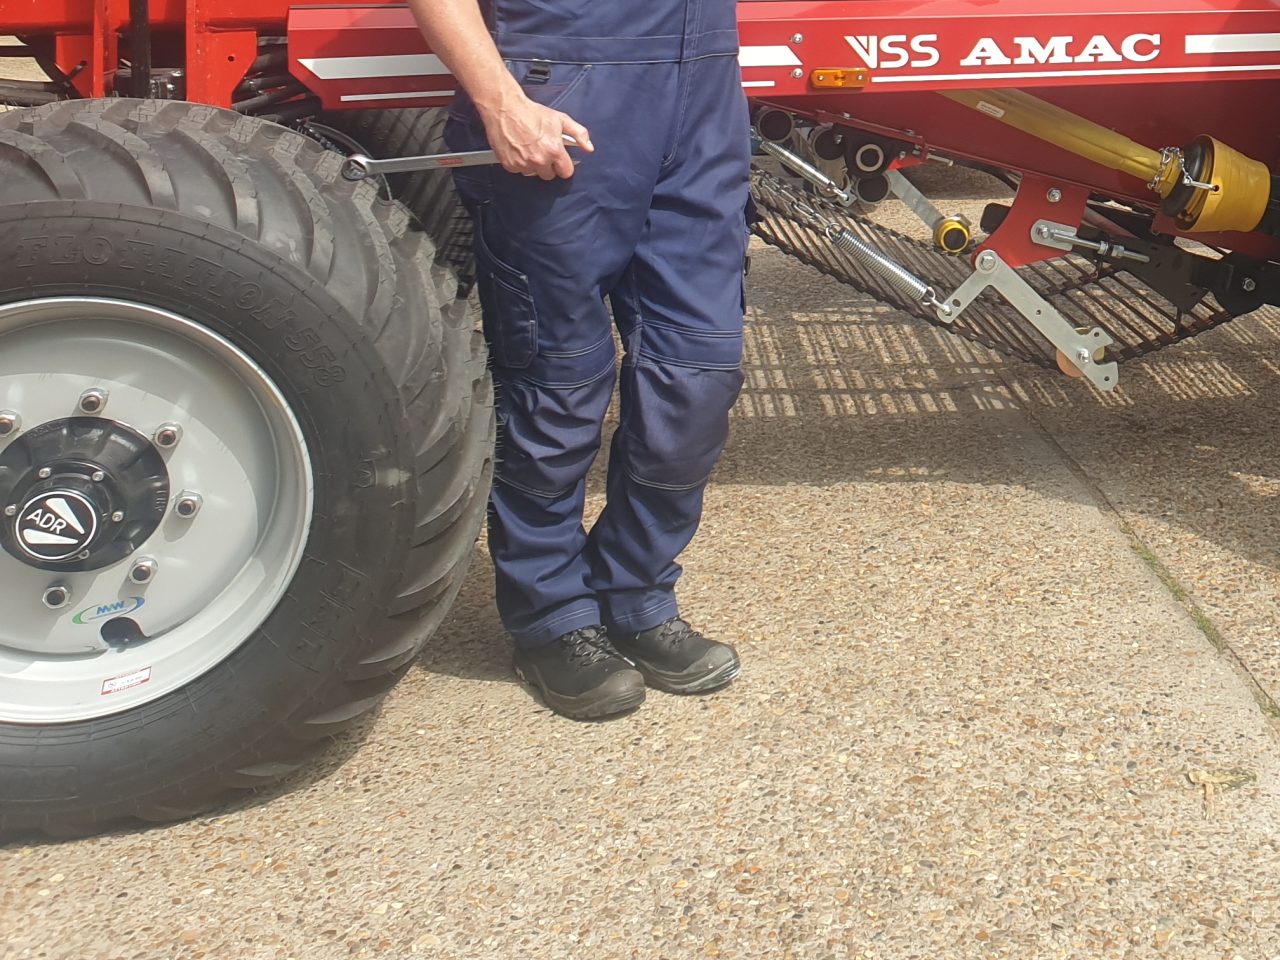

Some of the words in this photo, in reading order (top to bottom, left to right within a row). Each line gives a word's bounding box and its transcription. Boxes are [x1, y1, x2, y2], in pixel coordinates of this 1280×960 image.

[844, 34, 940, 69] VSS
[960, 33, 1161, 66] AMAC
[26, 508, 67, 535] ADR
